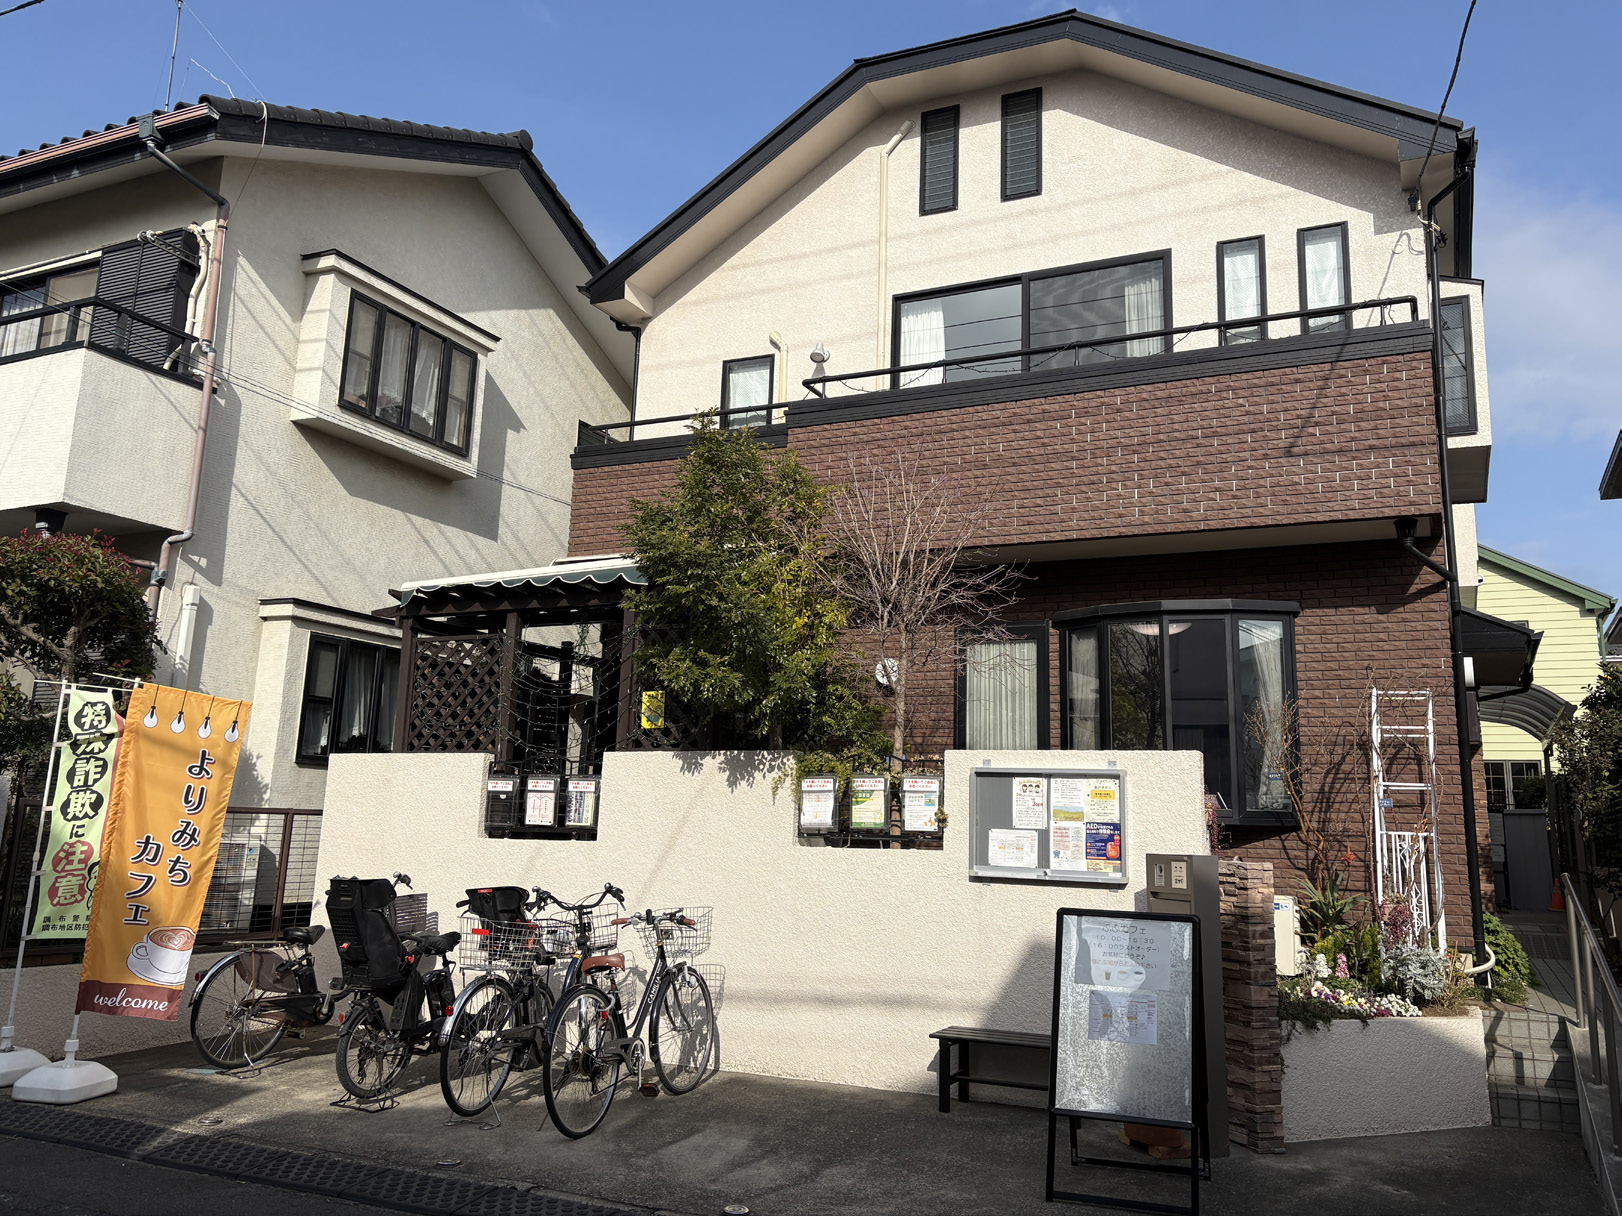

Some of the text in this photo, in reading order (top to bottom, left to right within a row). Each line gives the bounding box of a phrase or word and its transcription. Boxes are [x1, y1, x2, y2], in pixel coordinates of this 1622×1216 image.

[50, 701, 109, 906] 特殊詐欺に注意
[167, 749, 214, 886] よりみち
[123, 834, 163, 926] カフェ
[94, 987, 169, 1012] welcome
